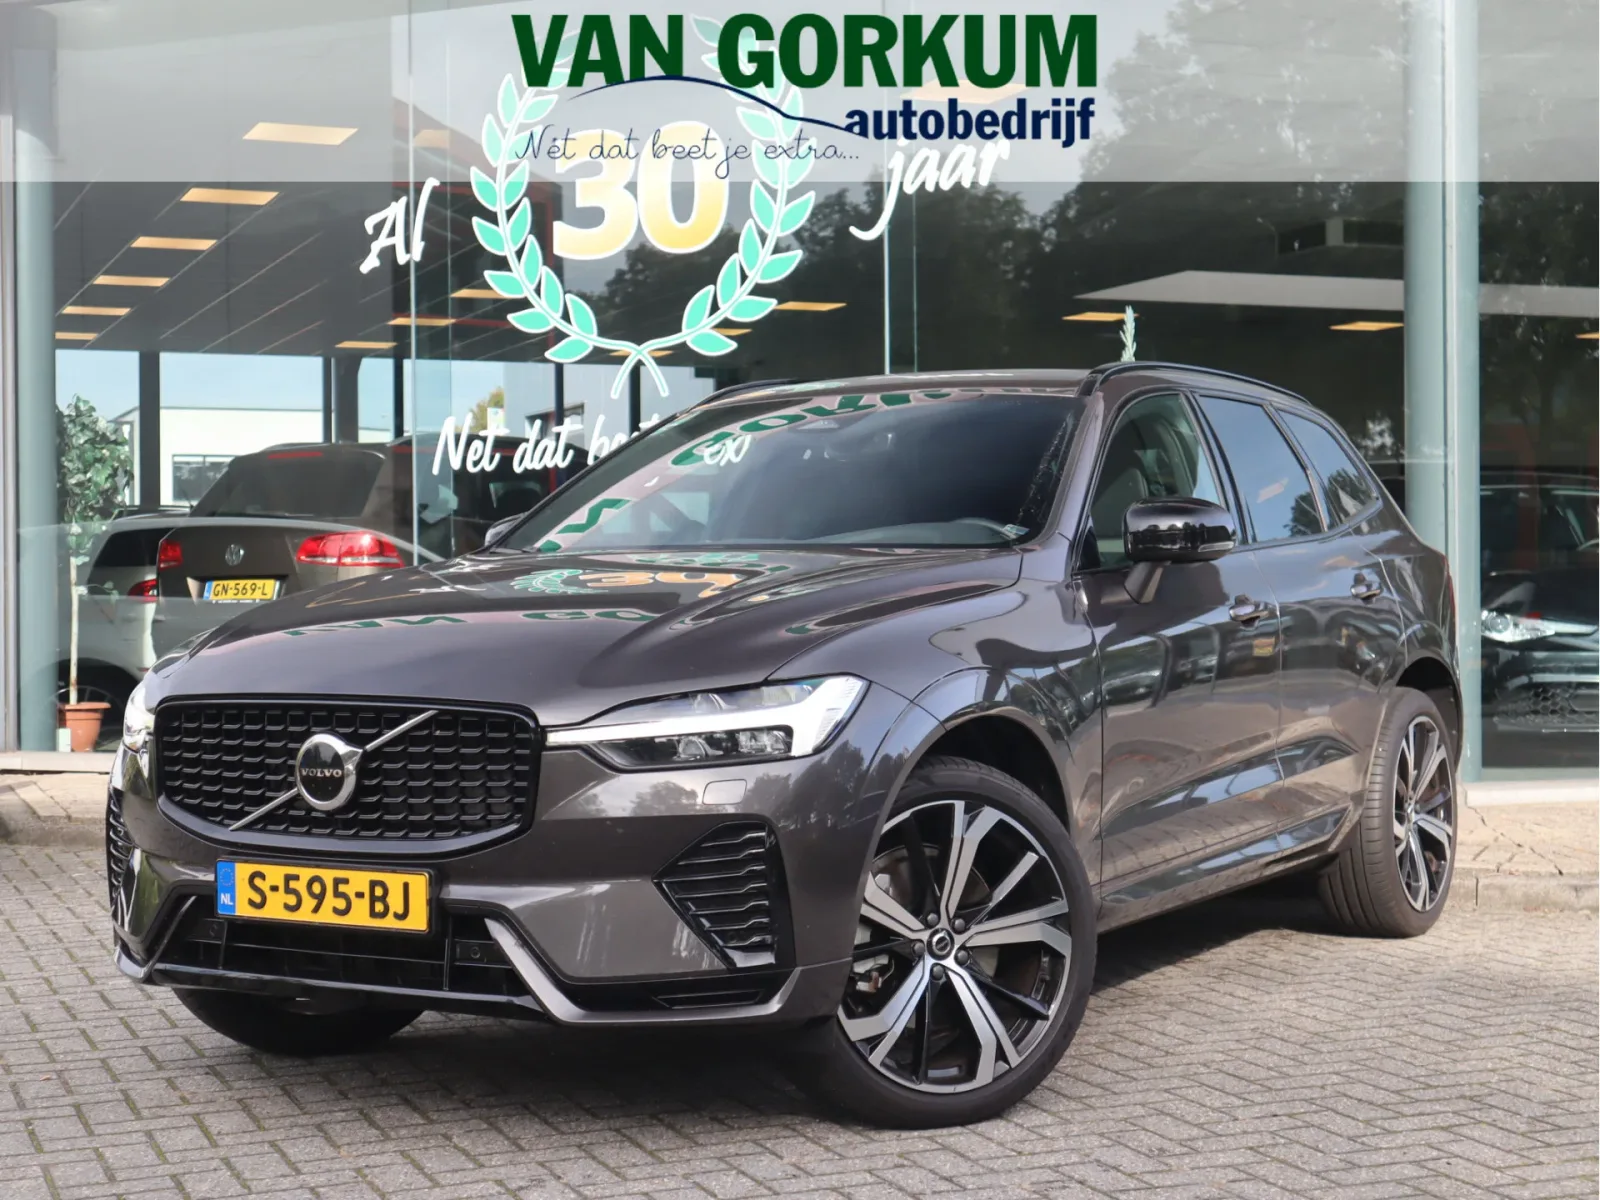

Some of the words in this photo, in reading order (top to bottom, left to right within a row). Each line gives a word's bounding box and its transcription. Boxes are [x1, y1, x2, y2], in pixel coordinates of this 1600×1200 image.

[552, 120, 730, 261] 30
[849, 136, 1011, 241] jaar
[432, 412, 510, 475] Net
[512, 418, 584, 474] dat
[213, 582, 268, 597] GN-569-L
[301, 767, 342, 778] VOLVO
[220, 892, 234, 906] NL
[247, 870, 411, 922] S-595-BJ
